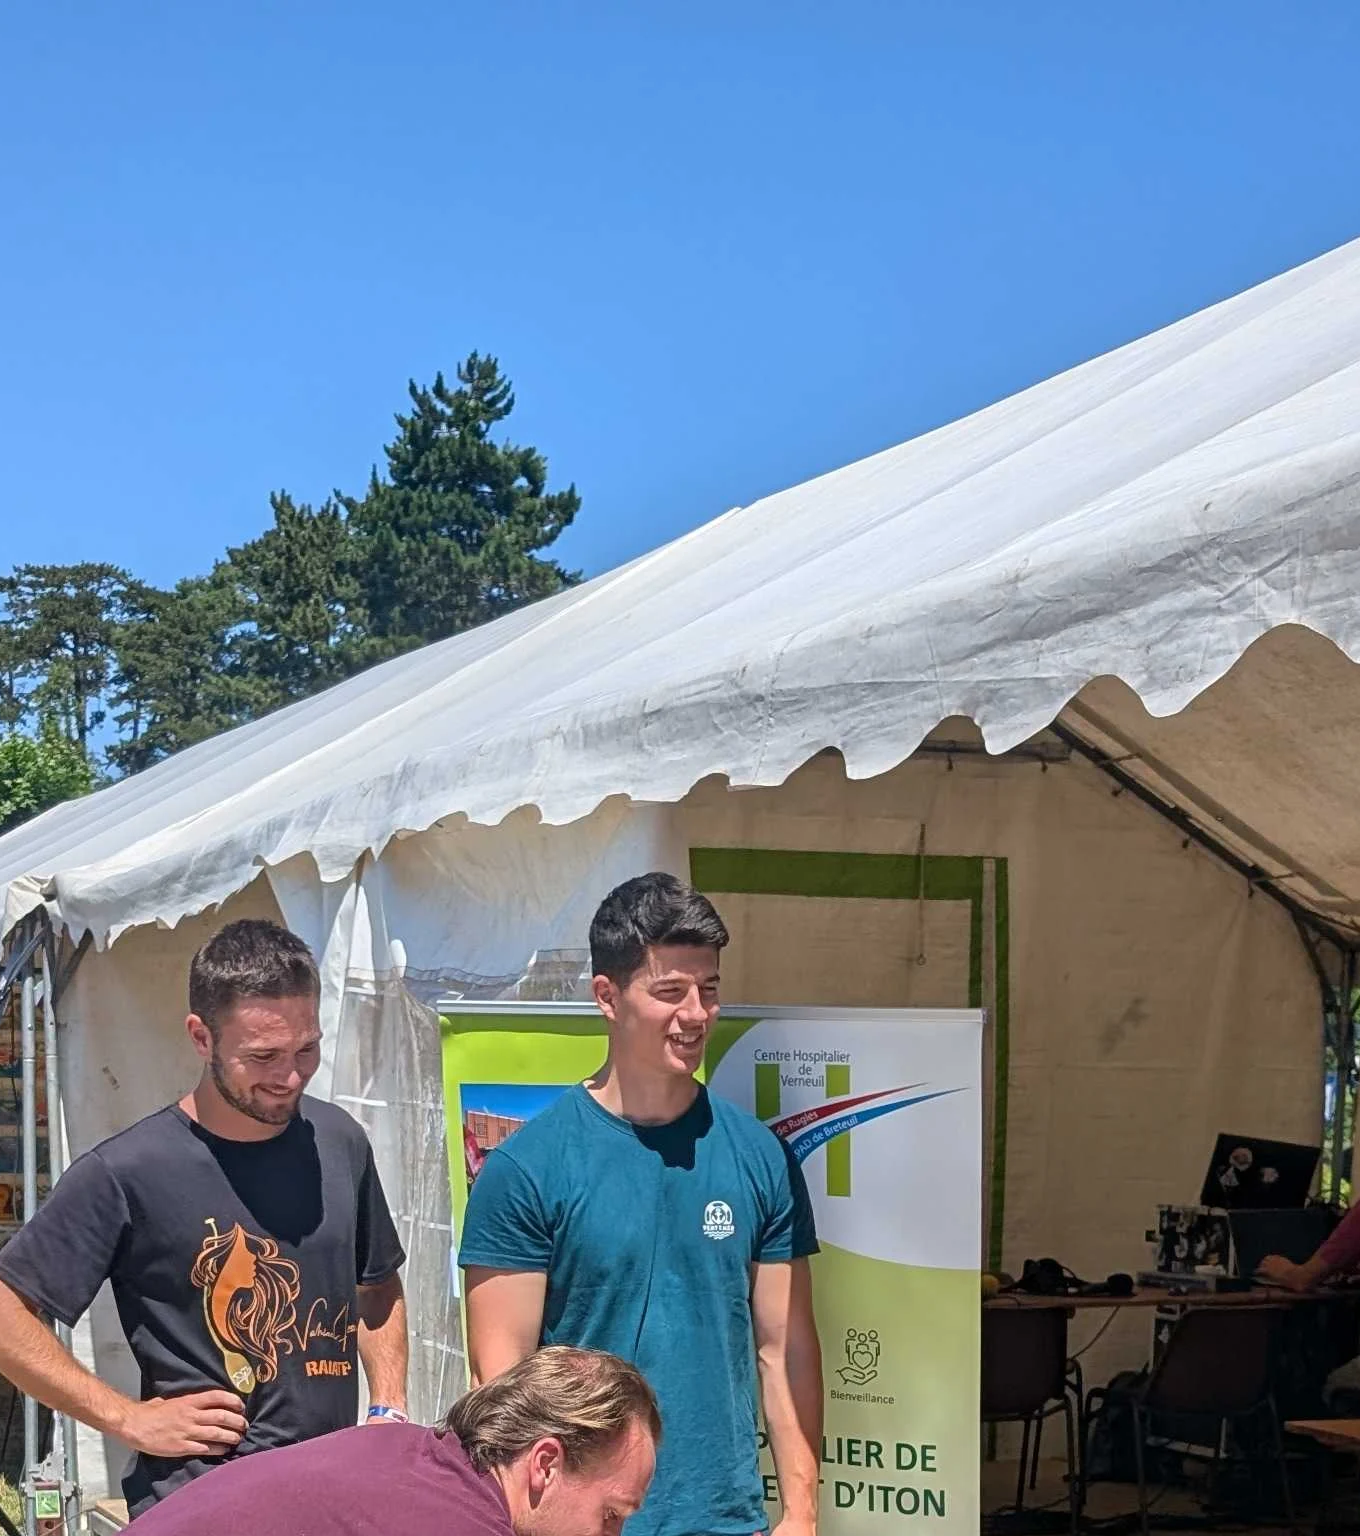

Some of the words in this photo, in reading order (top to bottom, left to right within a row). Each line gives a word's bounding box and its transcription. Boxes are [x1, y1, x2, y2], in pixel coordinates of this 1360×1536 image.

[754, 1049, 791, 1061] Centre
[793, 1050, 851, 1064] Hospitalier
[799, 1064, 812, 1075] de
[781, 1075, 824, 1087] Verneuil
[788, 1111, 819, 1129] Rugles
[812, 1132, 825, 1143] de
[823, 1115, 858, 1136] Breteuil
[830, 1389, 895, 1405] Bienveillance
[895, 1442, 937, 1472] DE
